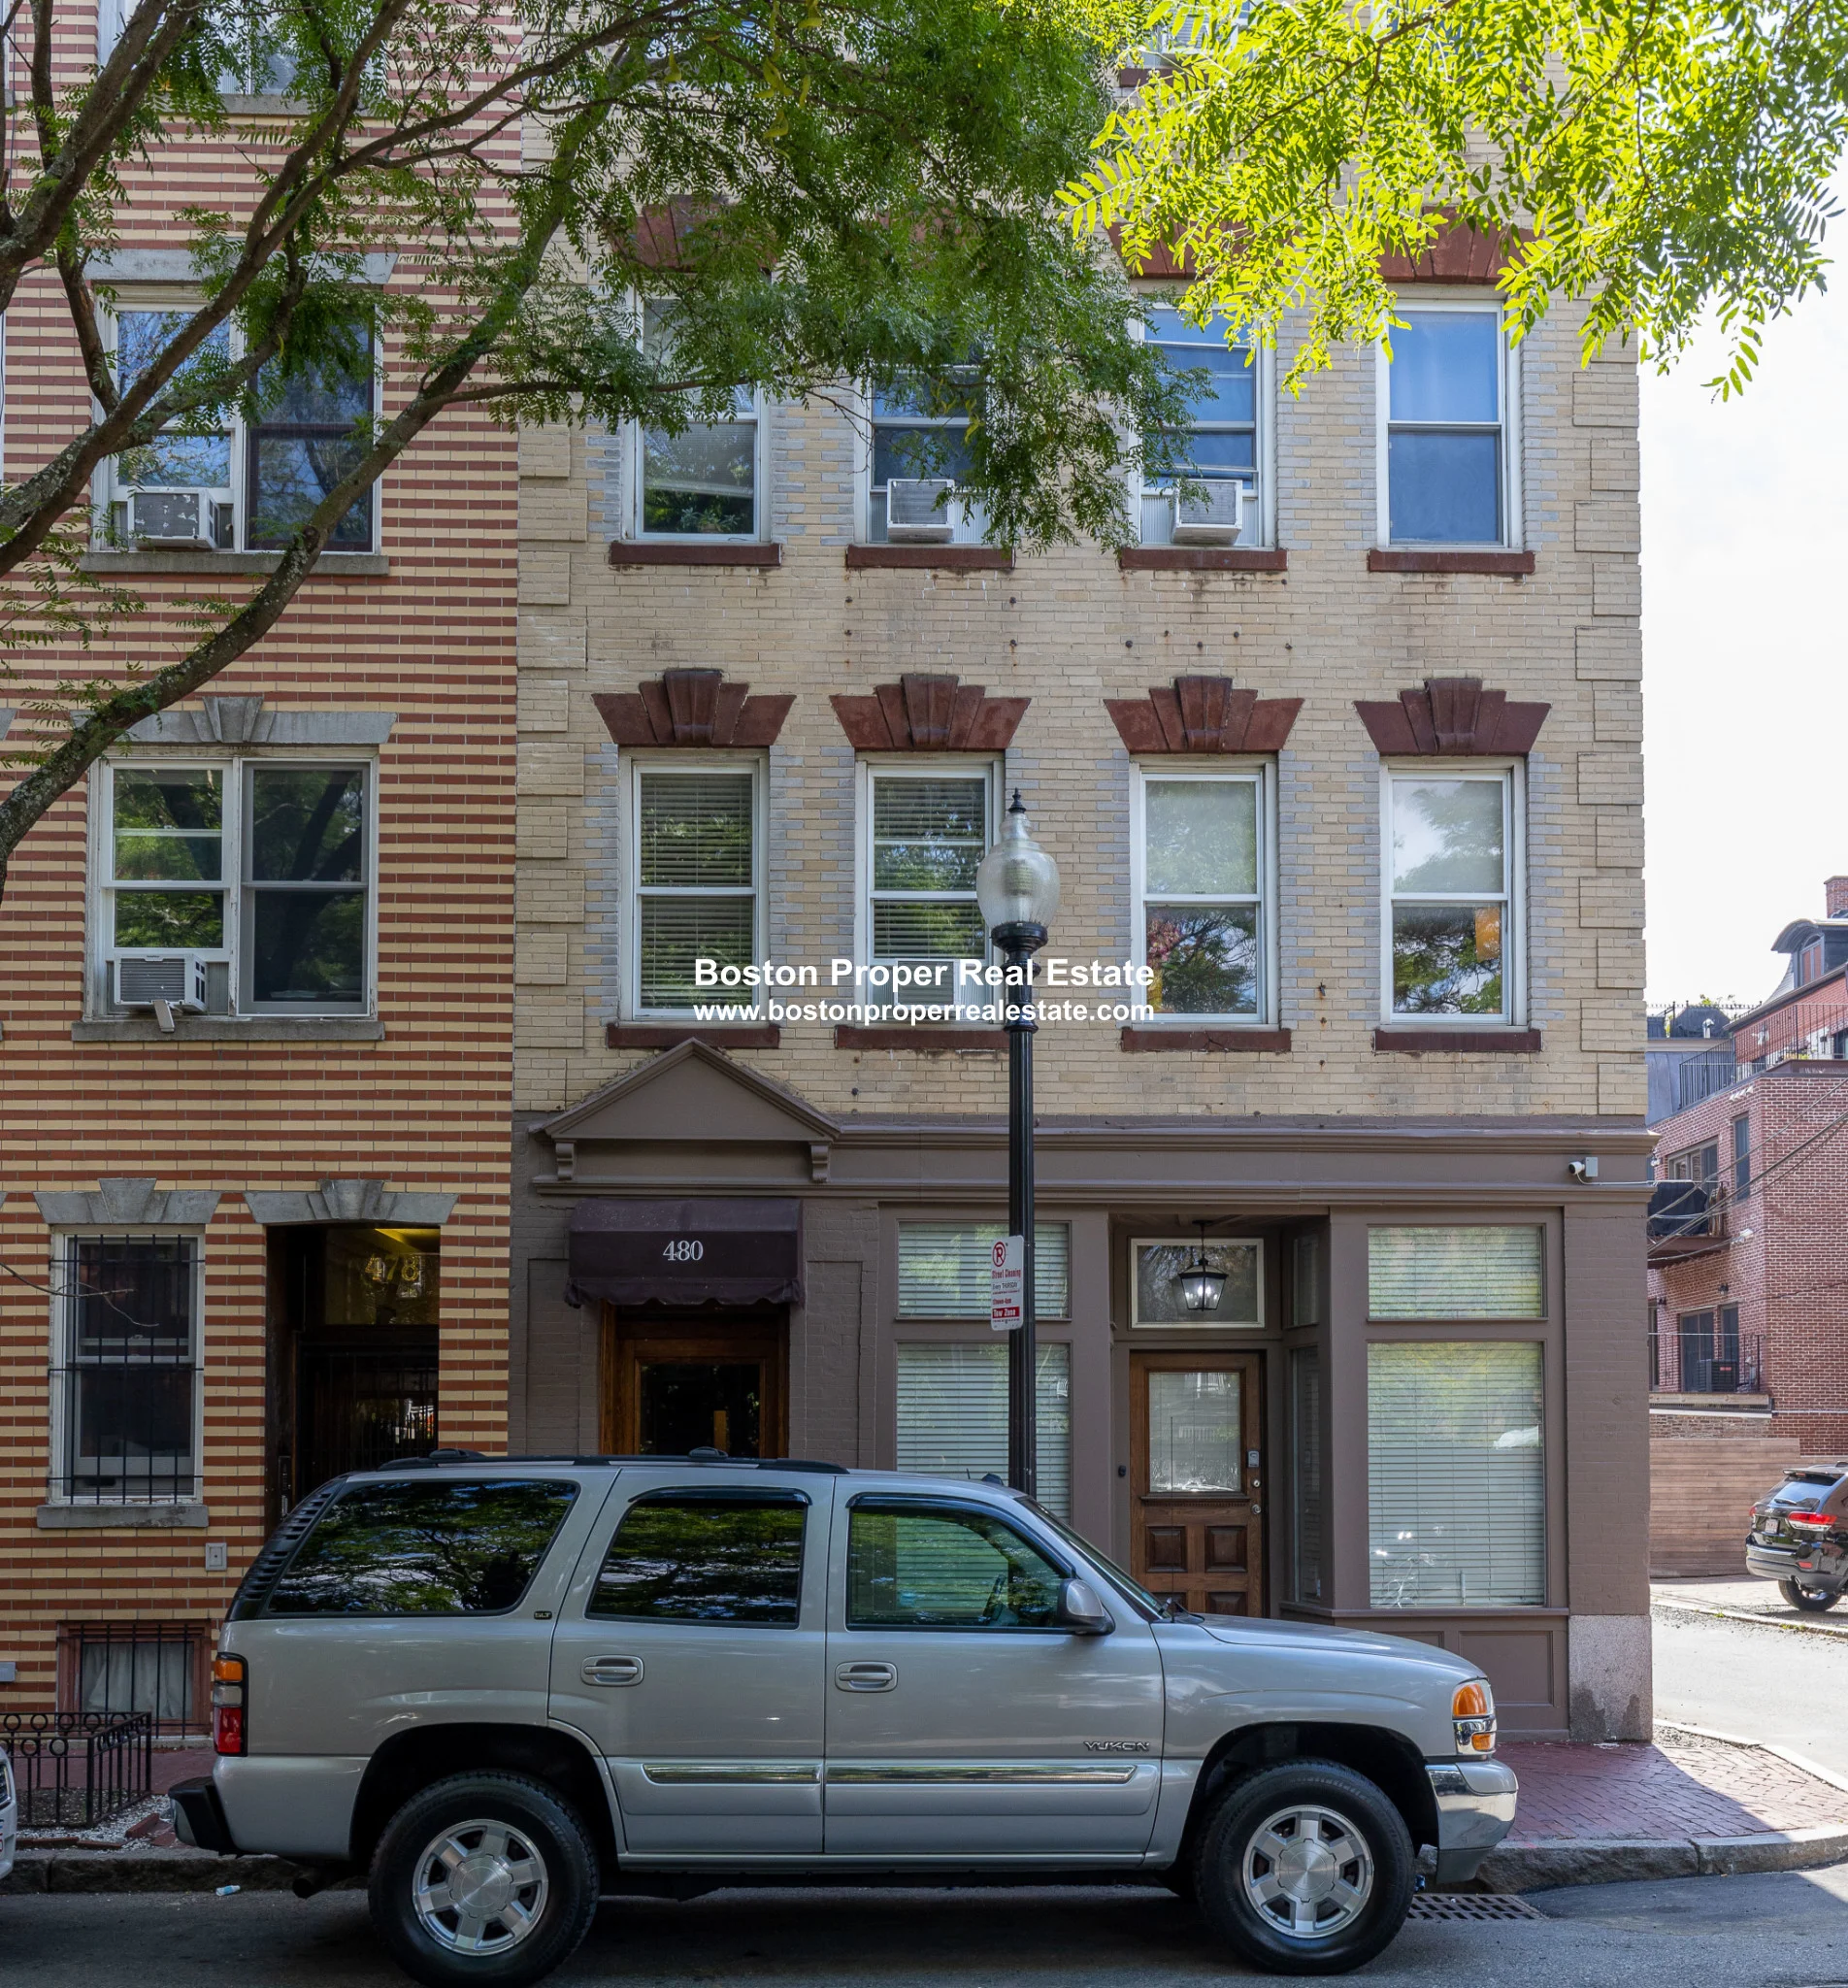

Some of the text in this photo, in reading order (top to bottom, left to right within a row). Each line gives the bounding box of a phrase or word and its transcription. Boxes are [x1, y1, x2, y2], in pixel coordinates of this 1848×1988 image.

[662, 1240, 704, 1261] 480
[993, 1308, 1016, 1317] Tow Zone
[1083, 1741, 1150, 1751] YUKON
